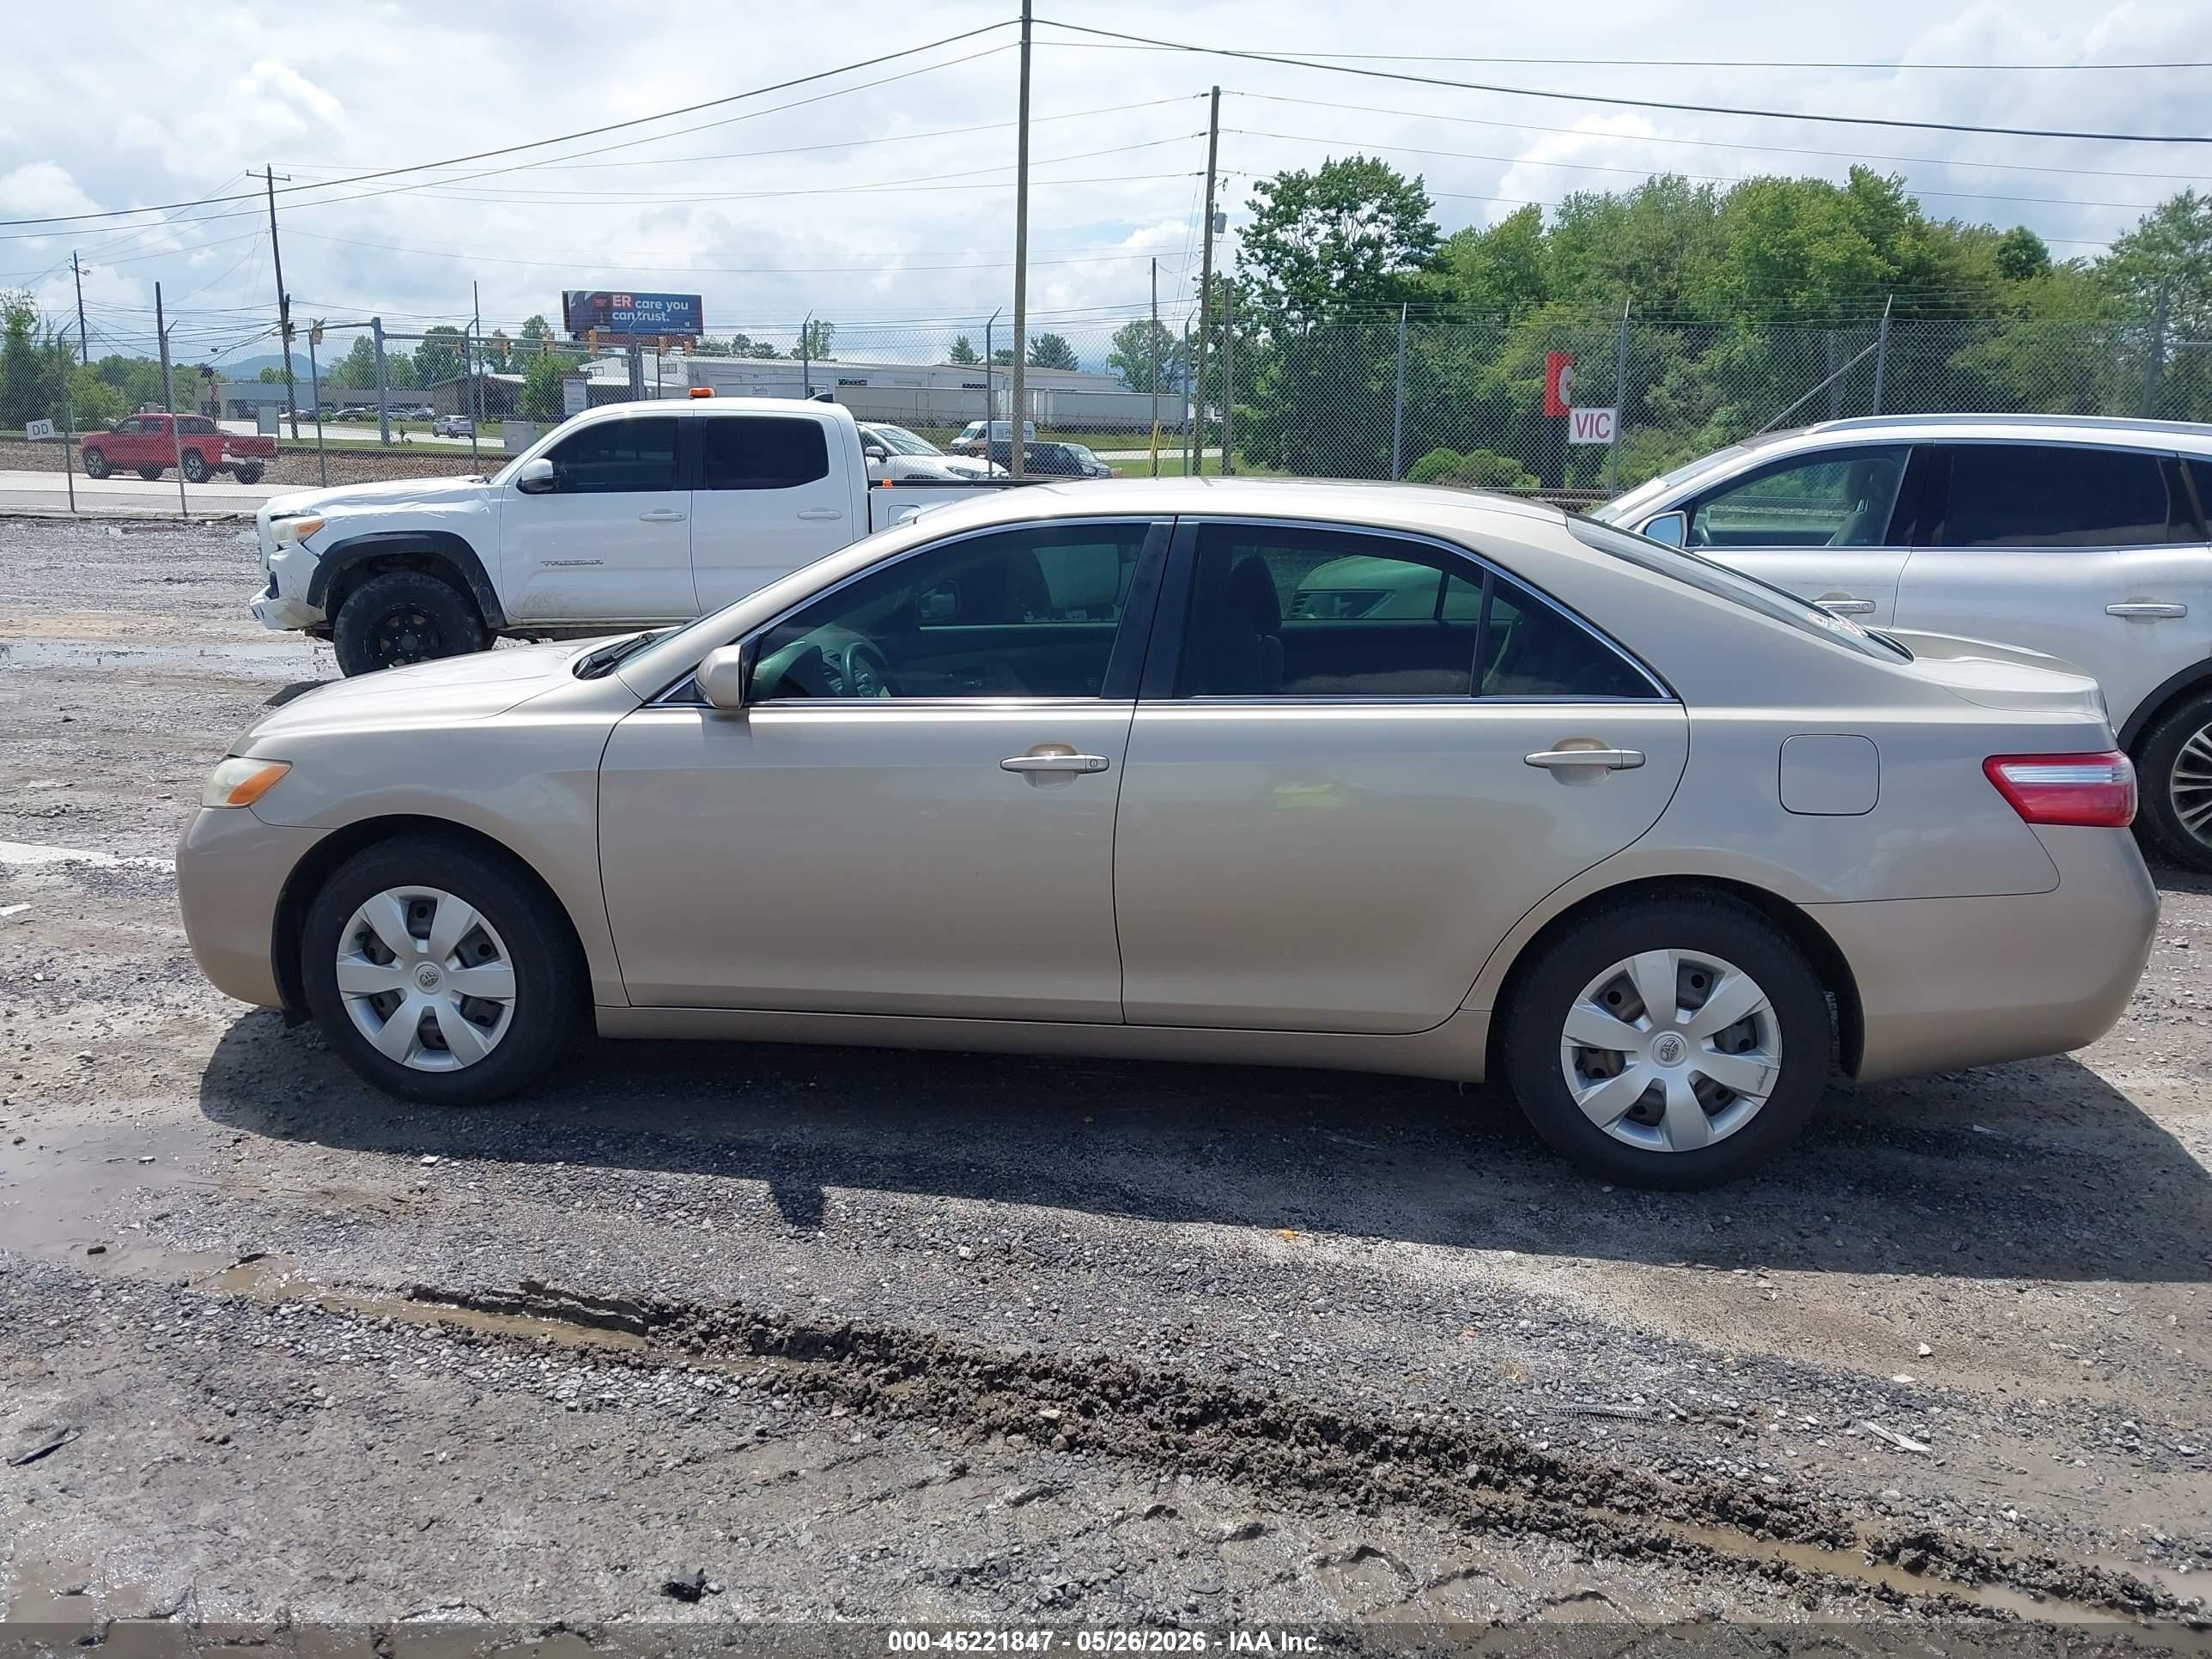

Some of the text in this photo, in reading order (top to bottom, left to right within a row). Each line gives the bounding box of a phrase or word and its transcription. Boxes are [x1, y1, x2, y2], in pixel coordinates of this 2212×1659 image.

[612, 295, 689, 312] ER care you
[612, 311, 670, 322] can trust.
[32, 423, 49, 435] DD
[1575, 412, 1610, 439] VIC
